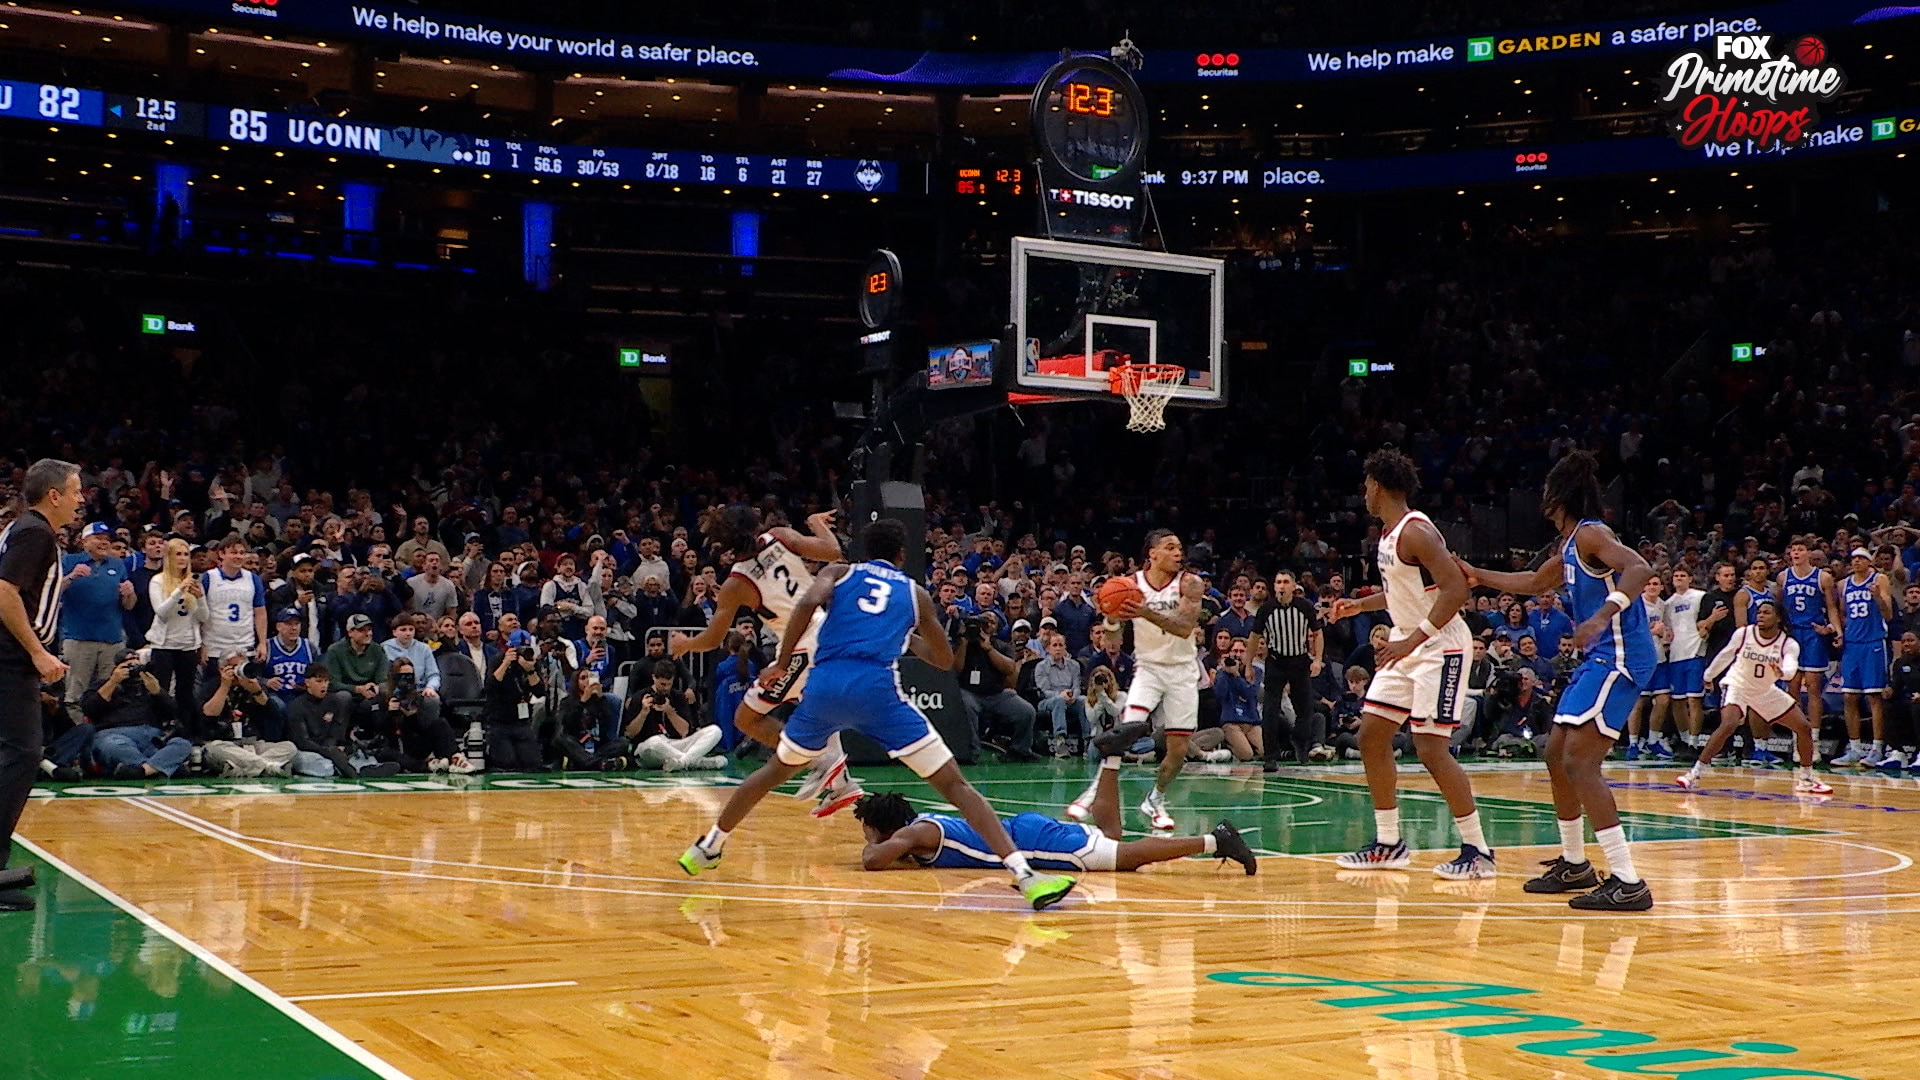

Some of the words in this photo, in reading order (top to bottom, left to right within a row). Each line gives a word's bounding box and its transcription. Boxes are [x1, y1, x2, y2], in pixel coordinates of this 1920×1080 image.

[231, 3, 278, 18] Securitas
[352, 7, 387, 30] We
[392, 15, 440, 41] help
[444, 23, 502, 45] make
[507, 32, 553, 54] your
[557, 38, 615, 57] world
[620, 44, 634, 58] a
[638, 42, 690, 62] safer
[697, 45, 760, 67] place.
[1308, 53, 1342, 72] We
[1346, 49, 1392, 71] help
[1396, 44, 1455, 65] make
[1469, 41, 1492, 57] TD
[1498, 31, 1601, 55] GARDEN
[1611, 30, 1626, 45] a
[1630, 23, 1690, 45] safer
[1693, 17, 1763, 42] place.
[1197, 66, 1239, 77] Securitas
[39, 84, 80, 120] 82
[1069, 83, 1111, 115] 12.3
[135, 97, 176, 121] 12.5
[146, 121, 165, 132] 2nd
[229, 108, 268, 142] 85
[288, 119, 381, 151] UCONN
[1873, 121, 1894, 136] TD
[475, 138, 490, 147] FLS
[506, 141, 522, 151] TOL
[538, 146, 559, 155] FG%
[593, 149, 606, 157] FG
[652, 152, 668, 161] 3PT
[701, 155, 714, 163] TO
[736, 156, 750, 165] STL
[771, 159, 788, 167] AST
[806, 160, 823, 168] REB
[475, 150, 491, 166] 10
[511, 153, 519, 168] 1
[534, 156, 562, 174] 56.6
[577, 160, 620, 177] 30/53
[645, 163, 679, 179] 8/18
[700, 166, 716, 181] 16
[738, 167, 748, 182] 6
[771, 170, 787, 185] 21
[806, 171, 822, 186] 27
[1140, 170, 1166, 184] ink
[1181, 170, 1218, 185] 9:37
[1222, 170, 1249, 184] PM
[1263, 167, 1325, 188] place.
[1072, 189, 1135, 211] TISSOT
[143, 317, 163, 331] TD
[167, 320, 196, 332] Bank
[621, 351, 638, 363] TD
[642, 353, 668, 363] Bank
[1733, 346, 1751, 359] TD
[1351, 362, 1367, 374] TD
[1370, 362, 1395, 372] Bank
[774, 564, 799, 598] 2
[1787, 583, 1817, 597] BYU
[857, 577, 893, 615] 3
[1794, 596, 1806, 612] 5
[1846, 590, 1873, 603] BYU
[228, 603, 240, 622] 3
[1849, 601, 1869, 619] 33
[1742, 650, 1780, 664] UCONN
[273, 661, 307, 676] BYU
[1754, 663, 1766, 679] 0
[1442, 656, 1461, 718] HUSKIES
[901, 686, 944, 710] ica
